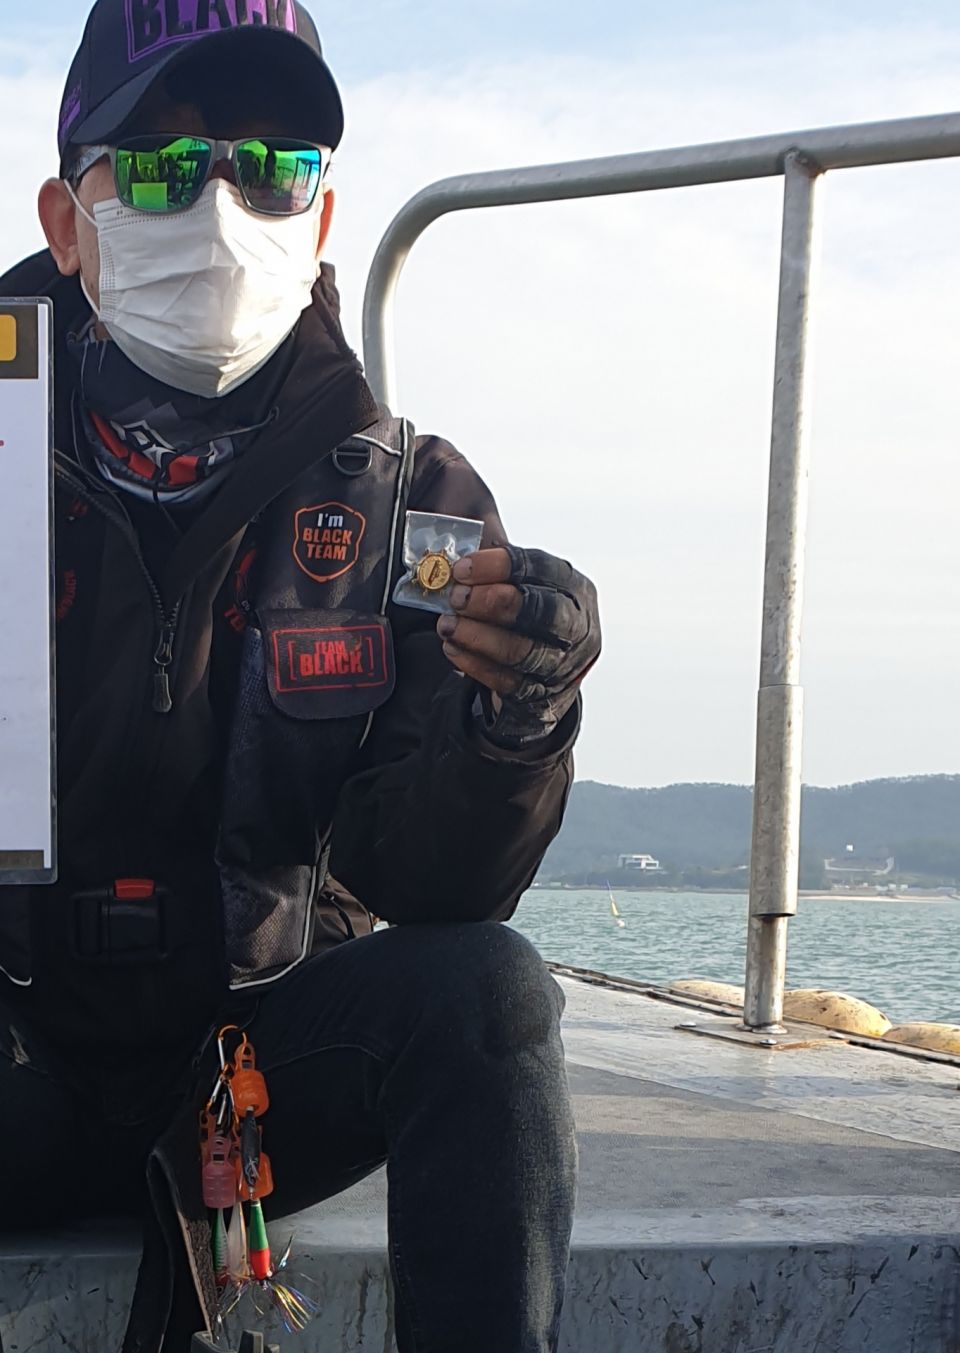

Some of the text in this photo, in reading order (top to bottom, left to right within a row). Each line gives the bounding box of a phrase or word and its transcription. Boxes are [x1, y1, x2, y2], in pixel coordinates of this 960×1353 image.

[317, 512, 344, 528] I'm
[302, 527, 353, 545] BLACK
[306, 544, 347, 561] TEAM
[299, 650, 364, 677] BLACK
